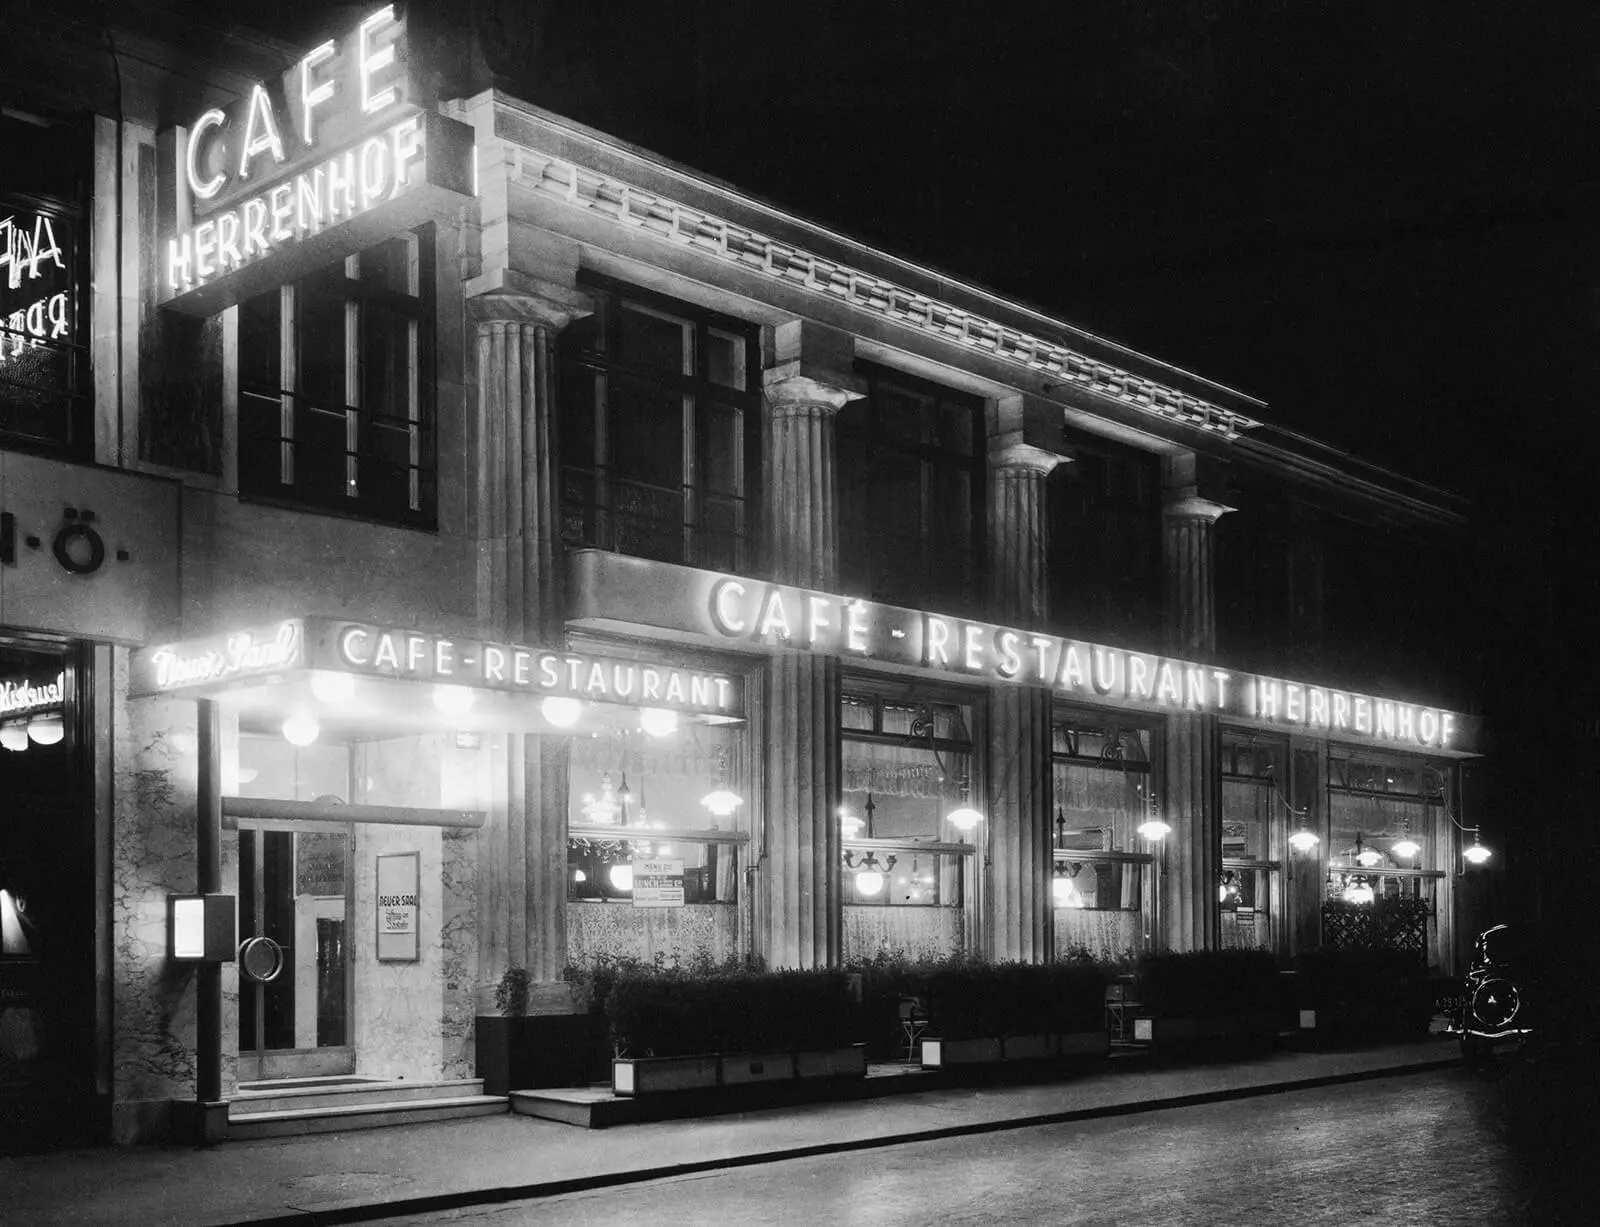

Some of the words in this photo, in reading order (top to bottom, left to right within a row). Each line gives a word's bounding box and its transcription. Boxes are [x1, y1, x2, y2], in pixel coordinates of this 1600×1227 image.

[187, 3, 395, 199] CAFE
[168, 118, 417, 290] HERRENHOF
[1259, 680, 1454, 745] HERRENHOF
[379, 895, 401, 907] NEUER
